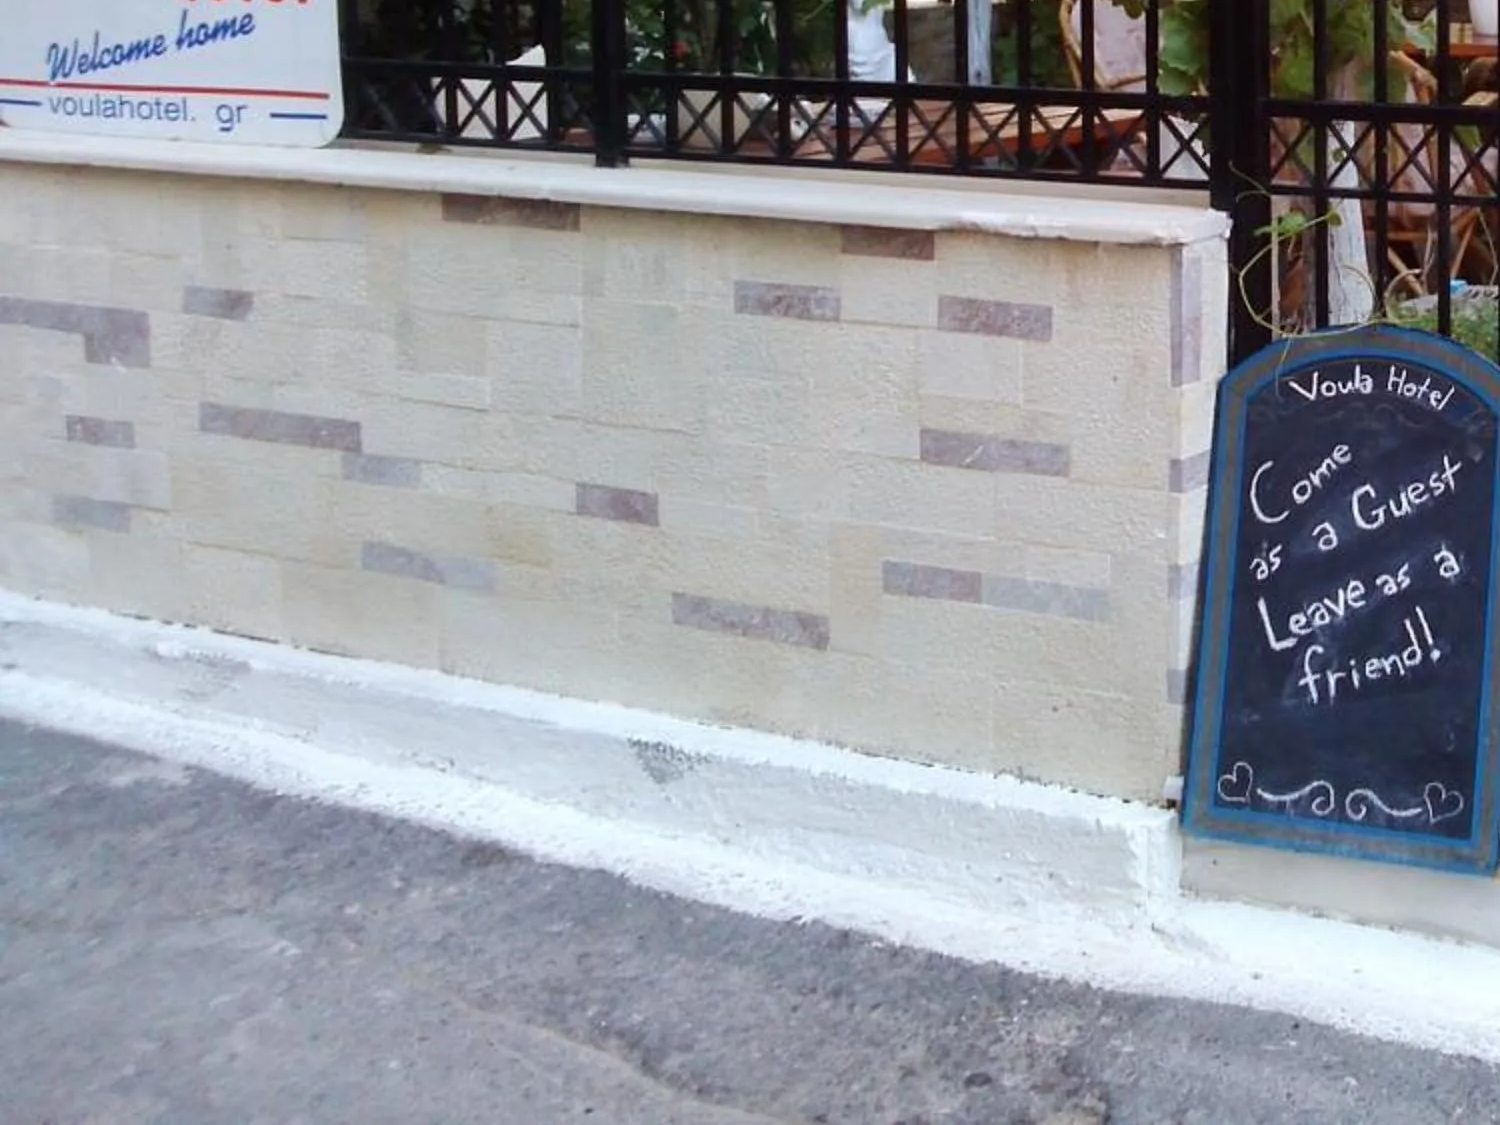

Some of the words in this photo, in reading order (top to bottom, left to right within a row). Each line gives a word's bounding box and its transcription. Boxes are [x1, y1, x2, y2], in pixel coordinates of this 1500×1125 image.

[46, 29, 168, 82] Welcome
[175, 8, 256, 59] home
[216, 100, 248, 133] gr
[1289, 364, 1374, 402] Voula
[1386, 366, 1458, 411] Hotel
[1249, 441, 1353, 524] Come
[1249, 543, 1283, 581] as
[1312, 521, 1339, 552] a
[1351, 454, 1465, 532] Guest
[1256, 578, 1366, 652] Leave
[1375, 559, 1412, 597] as
[1435, 545, 1462, 583] a
[1298, 605, 1443, 707] friend!
